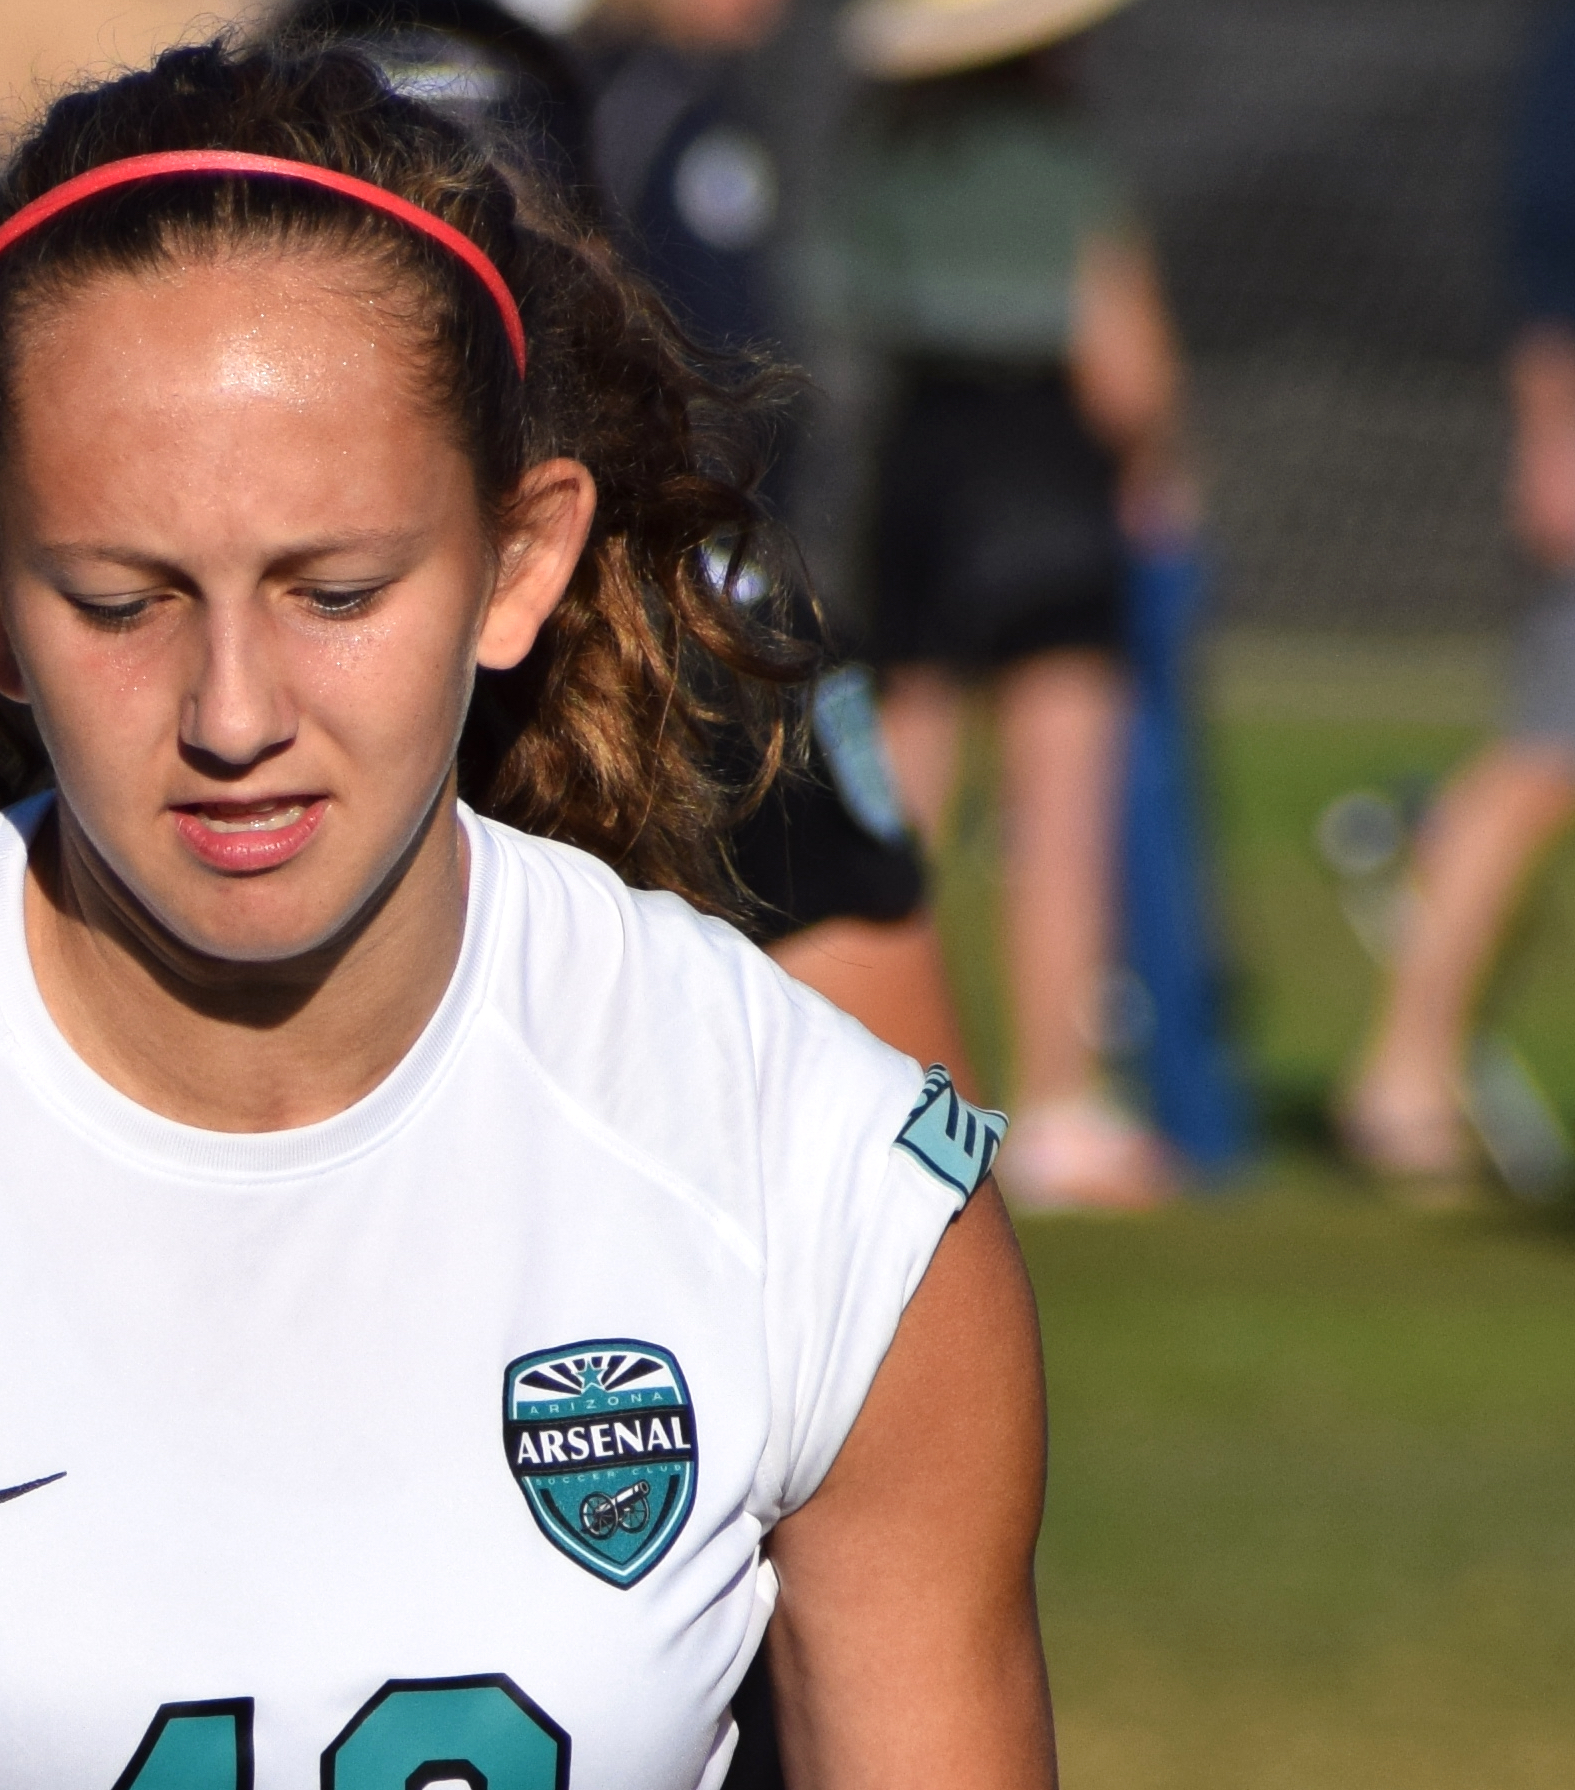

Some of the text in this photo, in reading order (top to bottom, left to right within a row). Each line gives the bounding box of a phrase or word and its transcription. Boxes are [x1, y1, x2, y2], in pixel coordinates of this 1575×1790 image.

[529, 1391, 664, 1415] ARIZONA
[516, 1416, 692, 1465] ARSENAL
[535, 1463, 683, 1486] SOCCER CLUB
